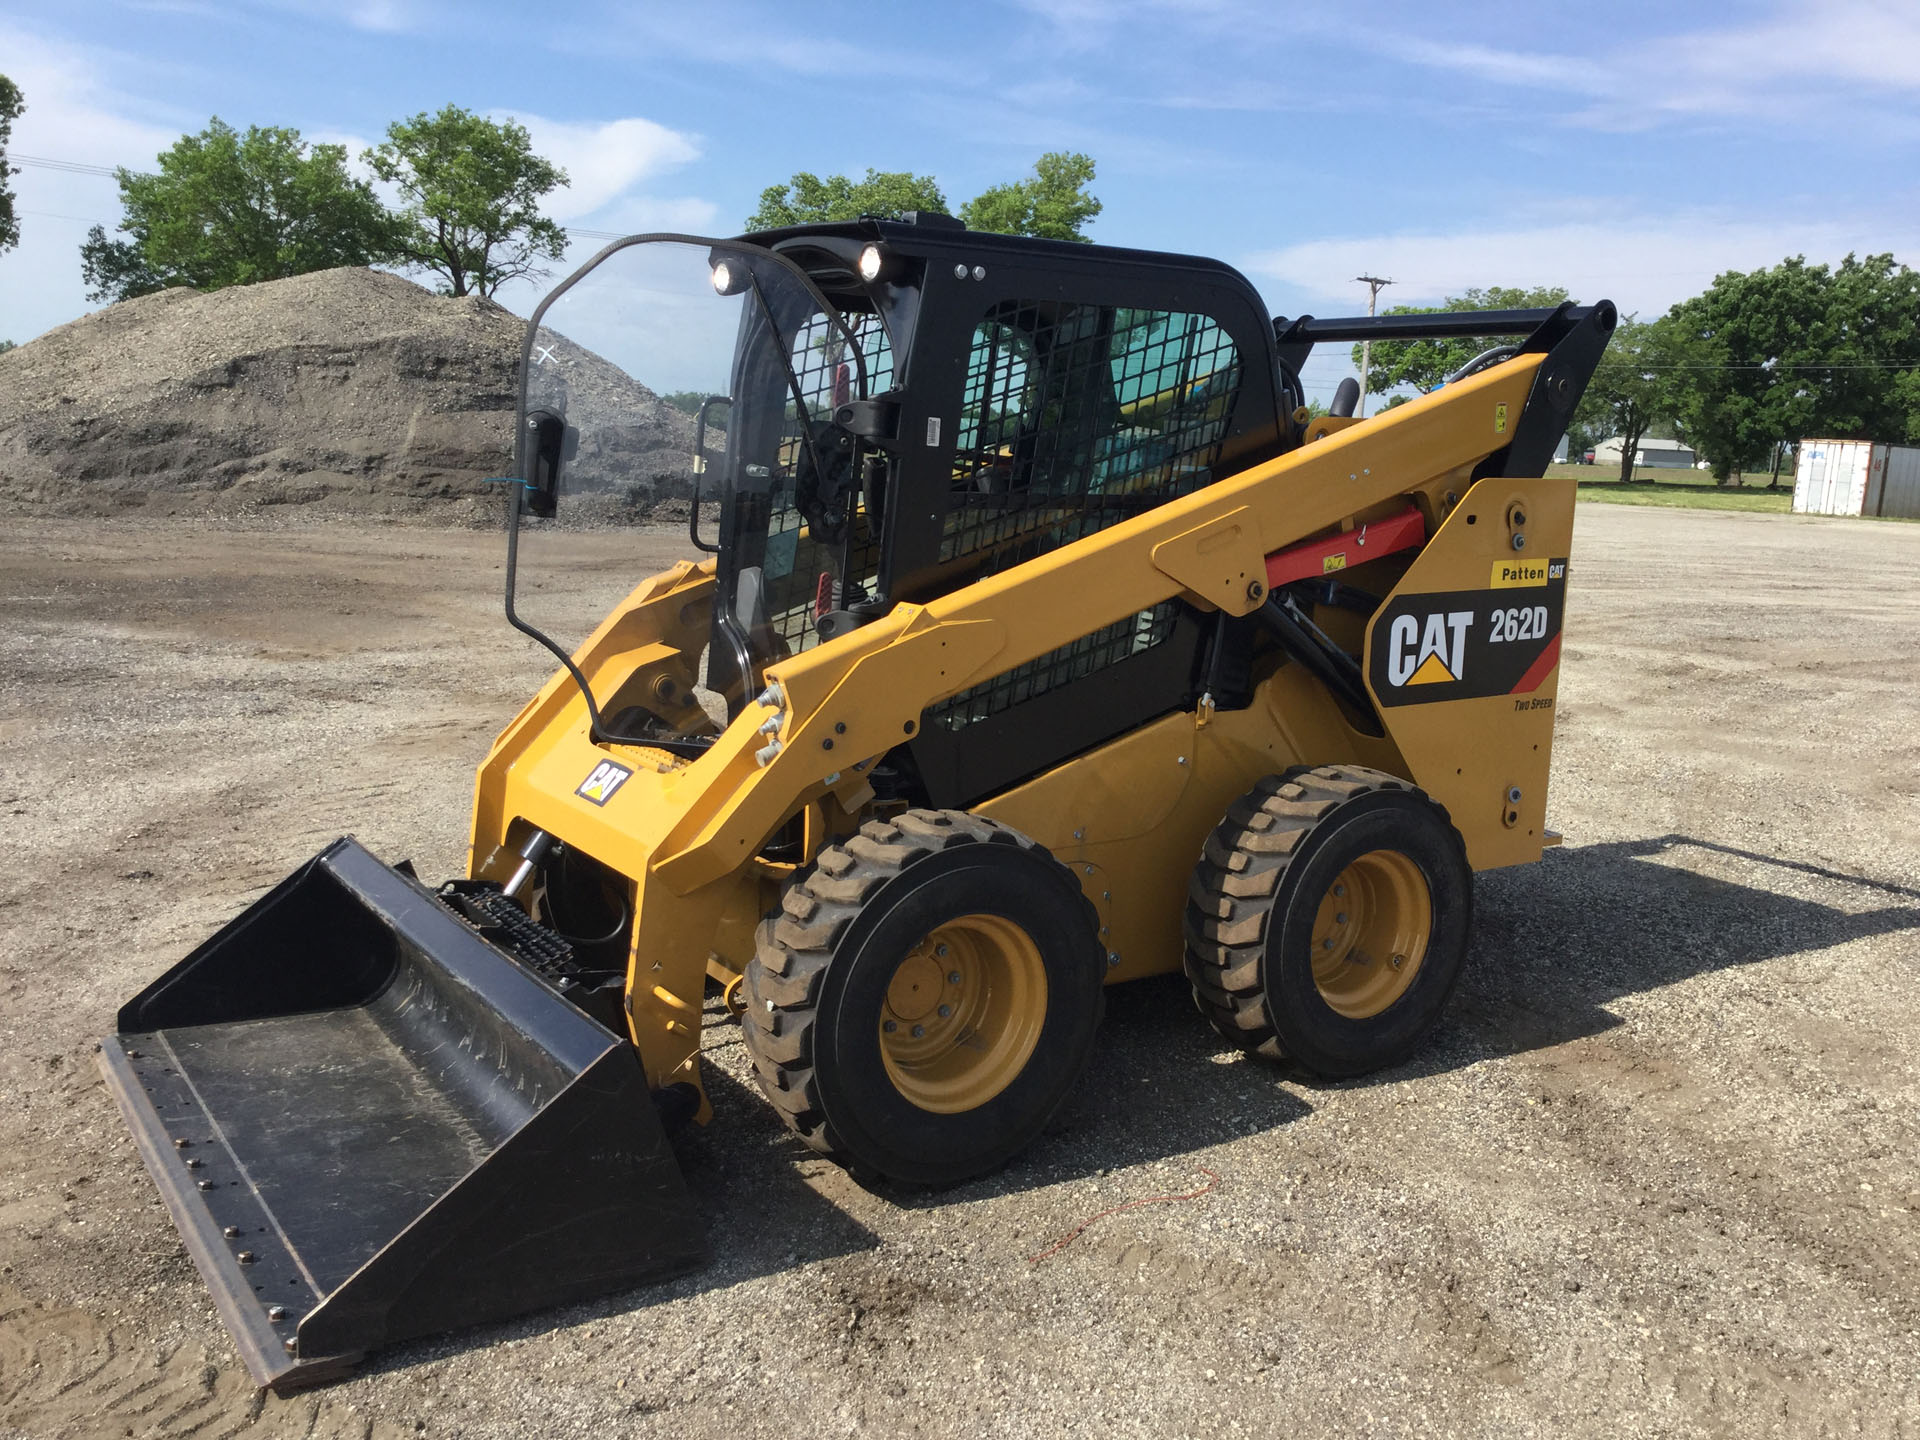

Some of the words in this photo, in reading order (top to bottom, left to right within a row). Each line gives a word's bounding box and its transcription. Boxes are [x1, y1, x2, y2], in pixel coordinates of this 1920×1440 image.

[1502, 567, 1544, 581] Patten
[1549, 565, 1565, 579] CAT
[1388, 611, 1474, 687] CAT
[1489, 606, 1548, 643] 262D
[580, 763, 629, 801] CAT
